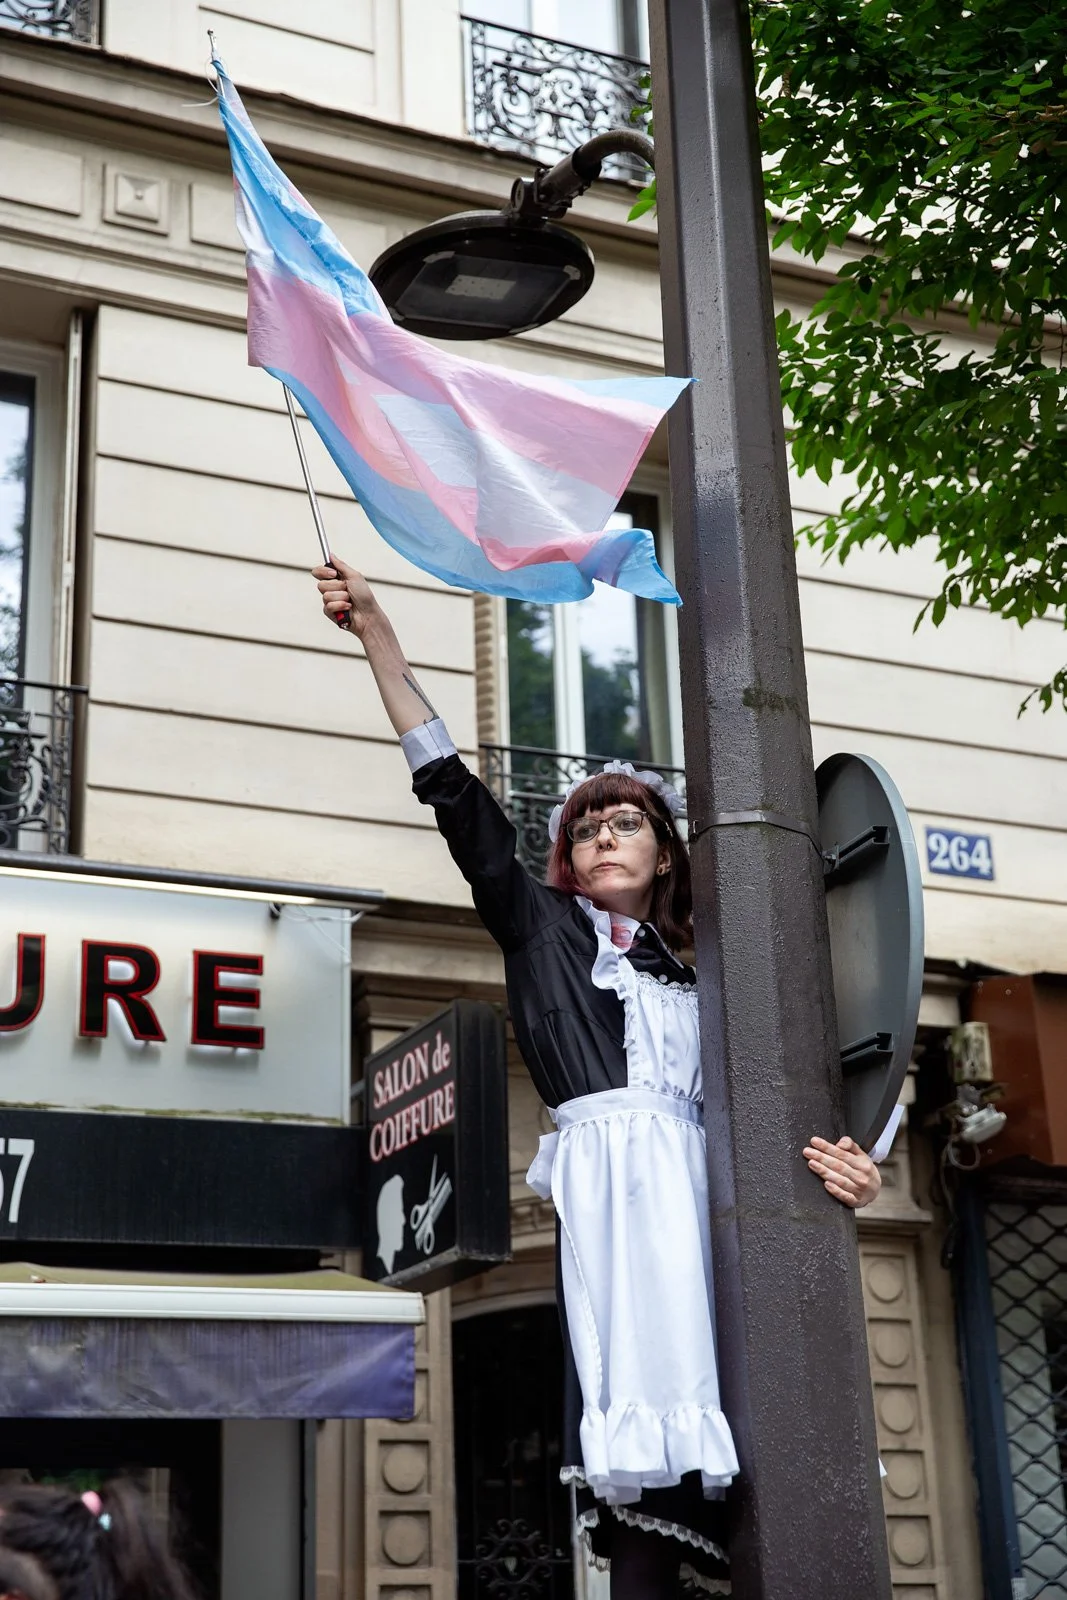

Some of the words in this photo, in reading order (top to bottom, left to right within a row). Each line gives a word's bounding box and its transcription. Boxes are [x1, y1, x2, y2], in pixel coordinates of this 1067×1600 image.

[928, 832, 992, 875] 264
[374, 1042, 429, 1109] SALON
[432, 1031, 450, 1073] de
[370, 1082, 455, 1162] COIFFURE
